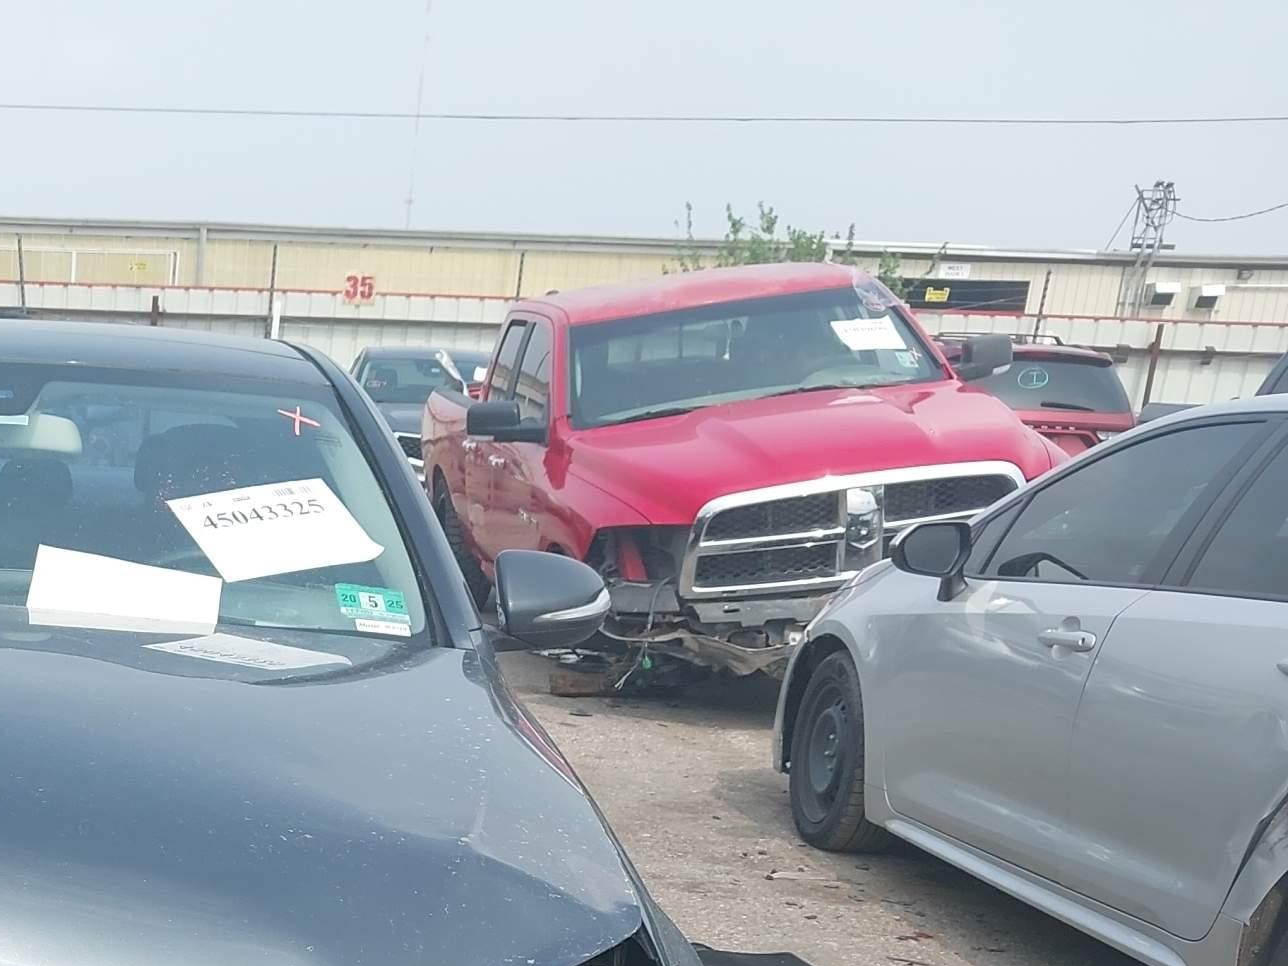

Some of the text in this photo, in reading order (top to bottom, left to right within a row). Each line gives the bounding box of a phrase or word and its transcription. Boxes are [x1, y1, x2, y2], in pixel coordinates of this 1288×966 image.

[344, 275, 374, 299] 35
[203, 498, 325, 529] 45043325
[367, 595, 379, 608] 5
